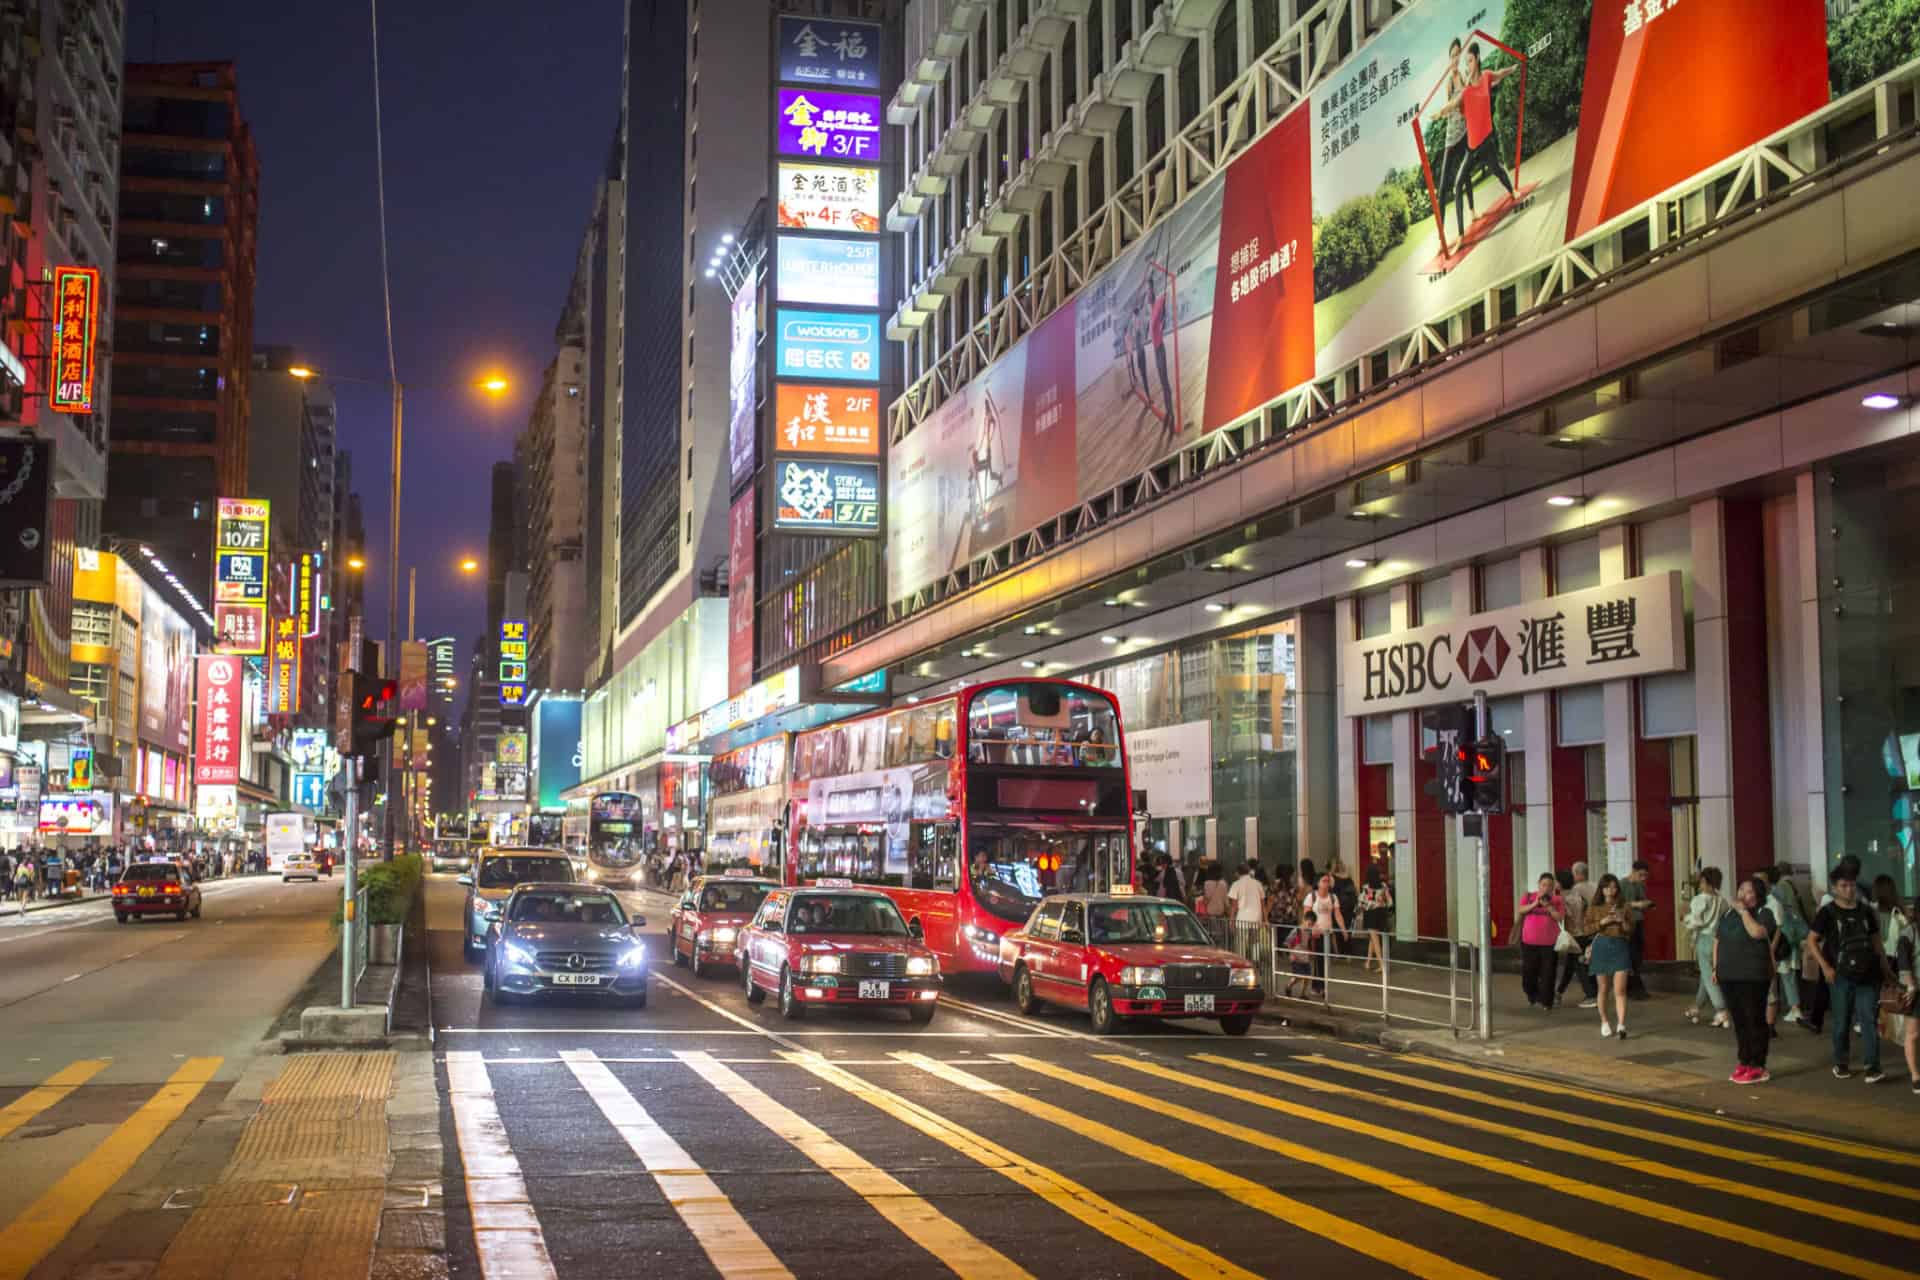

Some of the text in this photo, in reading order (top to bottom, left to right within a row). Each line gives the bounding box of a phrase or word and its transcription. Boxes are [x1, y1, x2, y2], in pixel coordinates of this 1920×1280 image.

[1624, 0, 1680, 37] 基金
[833, 134, 871, 155] 3/F
[818, 206, 842, 225] 4F
[796, 325, 860, 340] watsons
[58, 382, 82, 401] 4/F
[846, 396, 873, 413] 2/F
[224, 531, 262, 547] 10/F
[1362, 633, 1453, 701] HSBC
[574, 974, 595, 983] 1899
